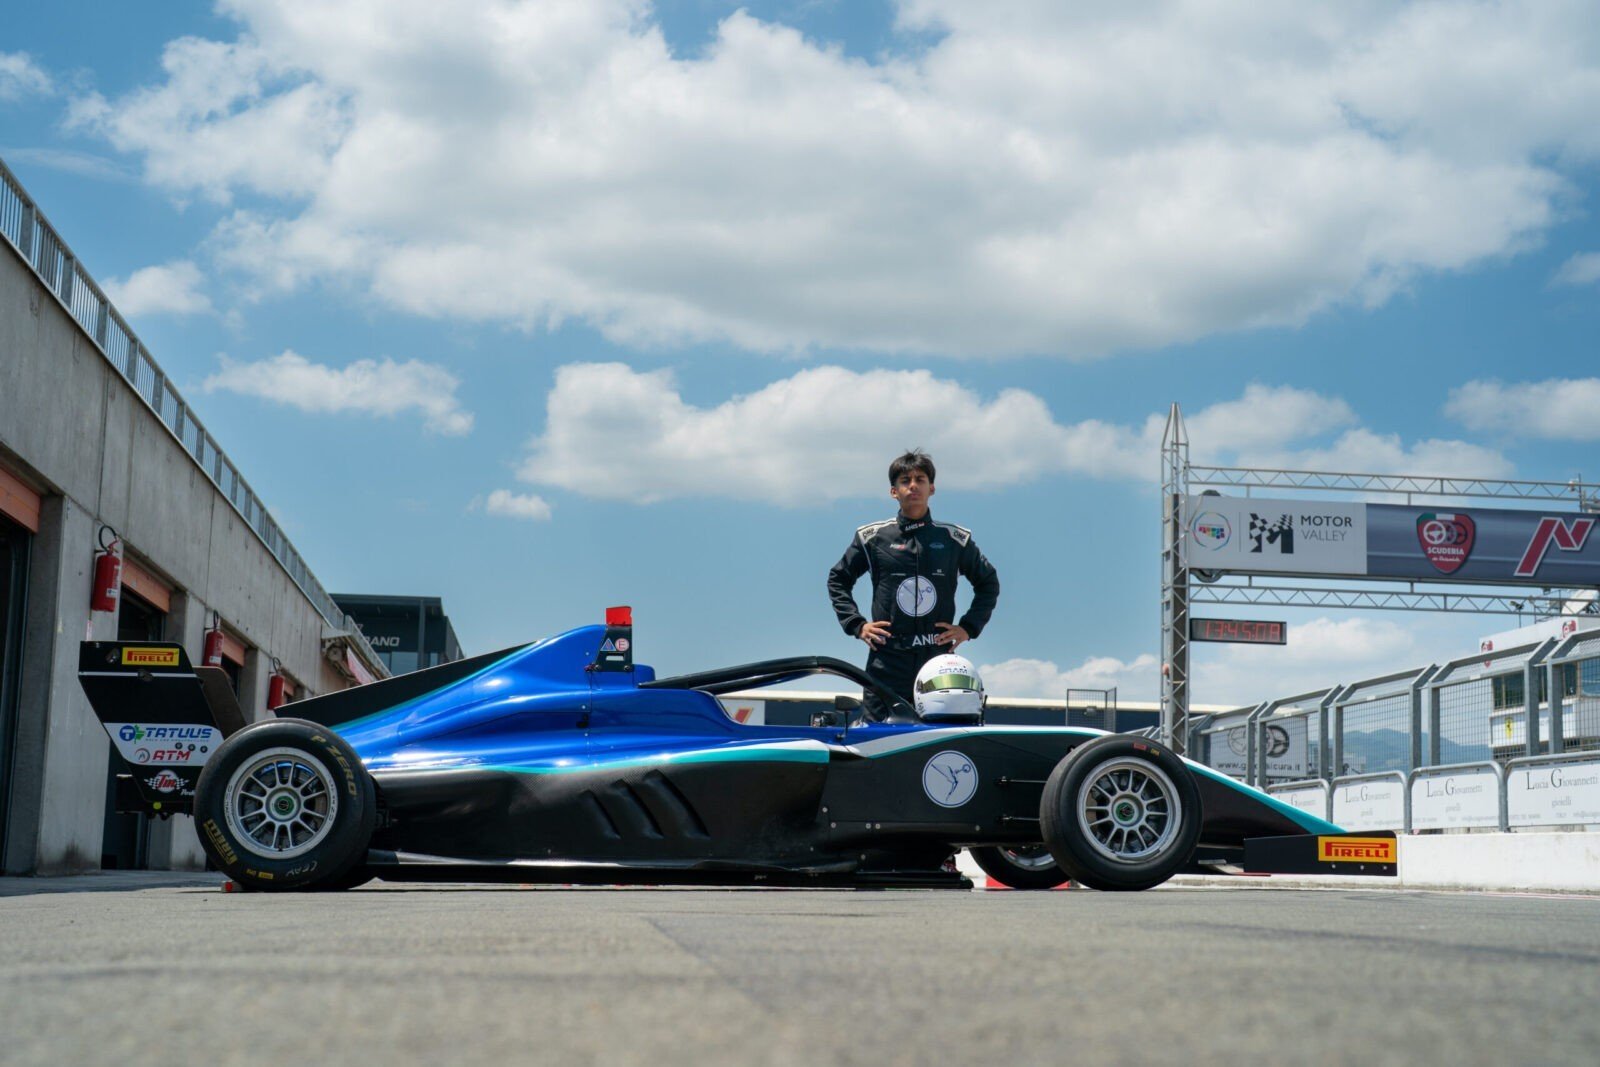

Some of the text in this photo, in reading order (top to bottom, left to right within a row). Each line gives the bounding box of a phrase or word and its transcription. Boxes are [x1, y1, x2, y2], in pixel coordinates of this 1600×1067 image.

[1300, 514, 1352, 528] MOTOR
[1302, 529, 1348, 542] VALLEY
[1427, 546, 1465, 555] SCUDERIA
[127, 650, 174, 662] PIRELLI
[145, 727, 213, 739] TATUUS
[1526, 768, 1598, 791] Lucia Giovannetti
[1324, 841, 1390, 858] PIRELLI
